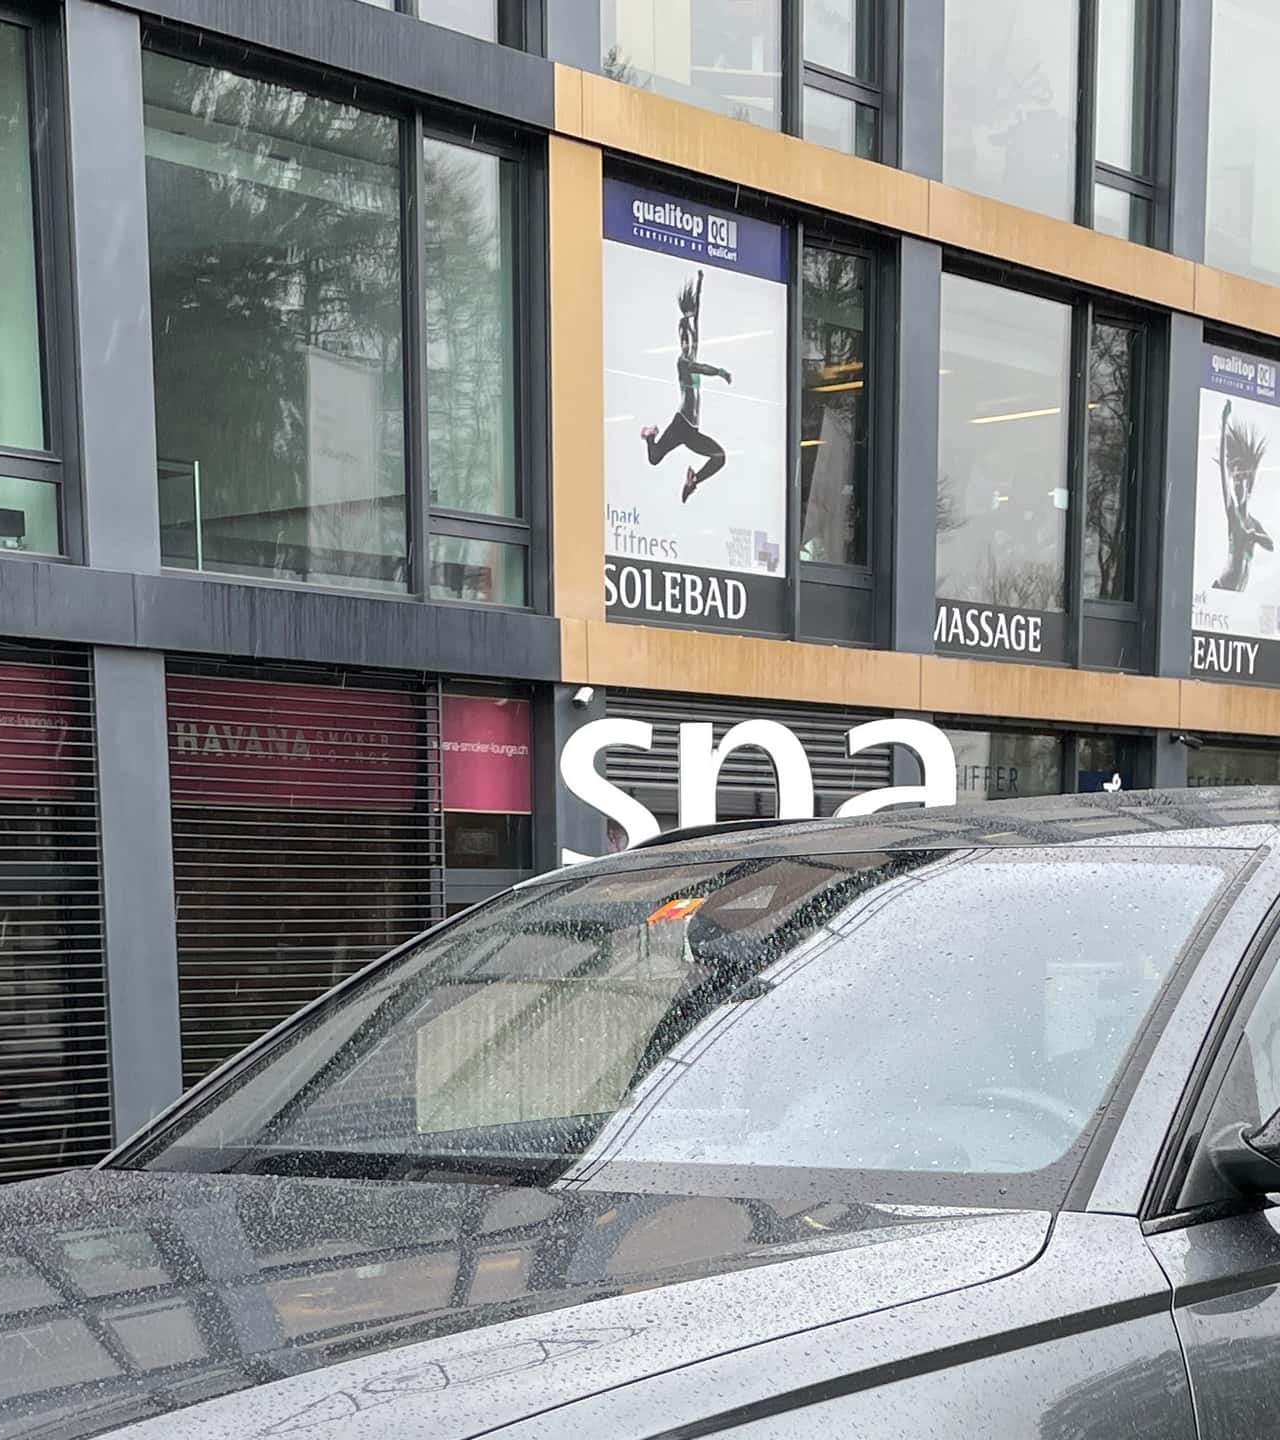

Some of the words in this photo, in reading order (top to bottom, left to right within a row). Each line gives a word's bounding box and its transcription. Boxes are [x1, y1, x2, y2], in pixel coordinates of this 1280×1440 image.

[632, 200, 704, 237] qualitop
[1211, 354, 1256, 381] qualitop
[613, 525, 679, 559] fitness
[604, 563, 747, 620] SOLEBAD
[1191, 636, 1259, 675] EAUTY
[175, 722, 312, 761] HAVANA
